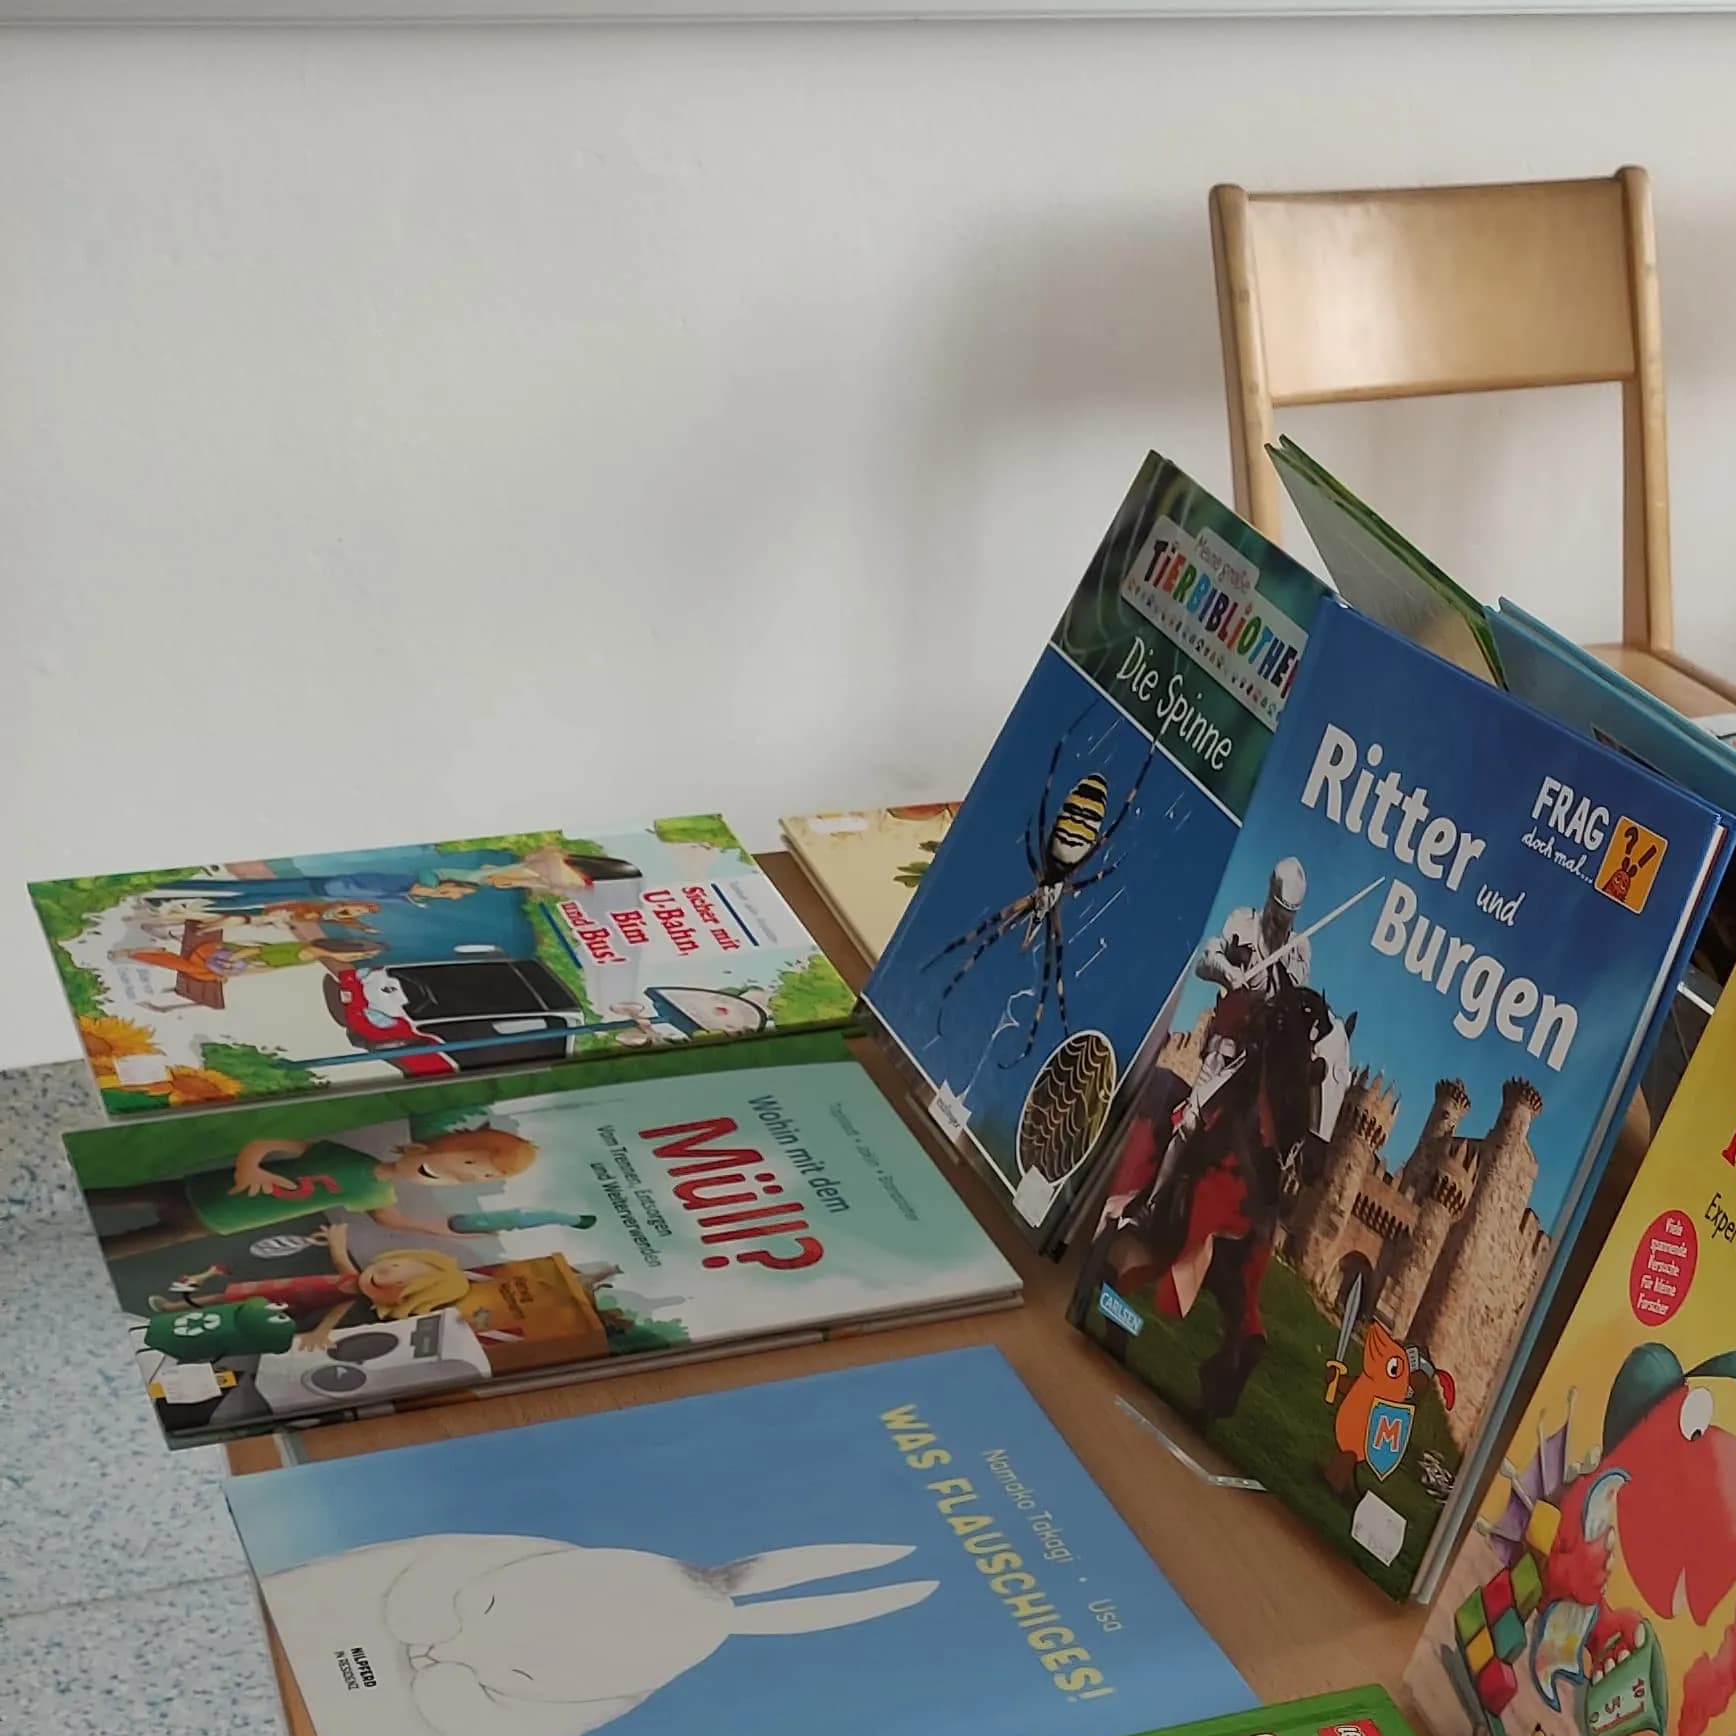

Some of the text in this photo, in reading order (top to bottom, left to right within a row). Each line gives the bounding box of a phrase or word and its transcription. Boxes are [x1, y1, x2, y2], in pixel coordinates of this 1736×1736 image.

[1116, 636, 1233, 770] Die Spinne
[1300, 723, 1527, 927] Ritter und
[1520, 826, 1554, 859] doch
[1531, 776, 1610, 851] FRAG
[561, 902, 627, 964] und Bus!
[611, 910, 650, 945] Bim
[642, 889, 700, 957] U-Bahn,
[682, 886, 741, 951] Sicher mit
[1370, 879, 1578, 1072] Burgen
[597, 1124, 673, 1238] Vom Trennen, Entsorgen
[748, 1095, 850, 1213] Wohin mit dem
[590, 1161, 662, 1267] und Weiterverwenden
[638, 1116, 825, 1270] Müll?
[1099, 1290, 1142, 1334] CARLSEN
[1372, 1415, 1403, 1454] M
[880, 1403, 1117, 1703] WAS FLAUSCHIGES!
[1087, 1598, 1123, 1633] Usa
[350, 1647, 377, 1689] NILPFERD
